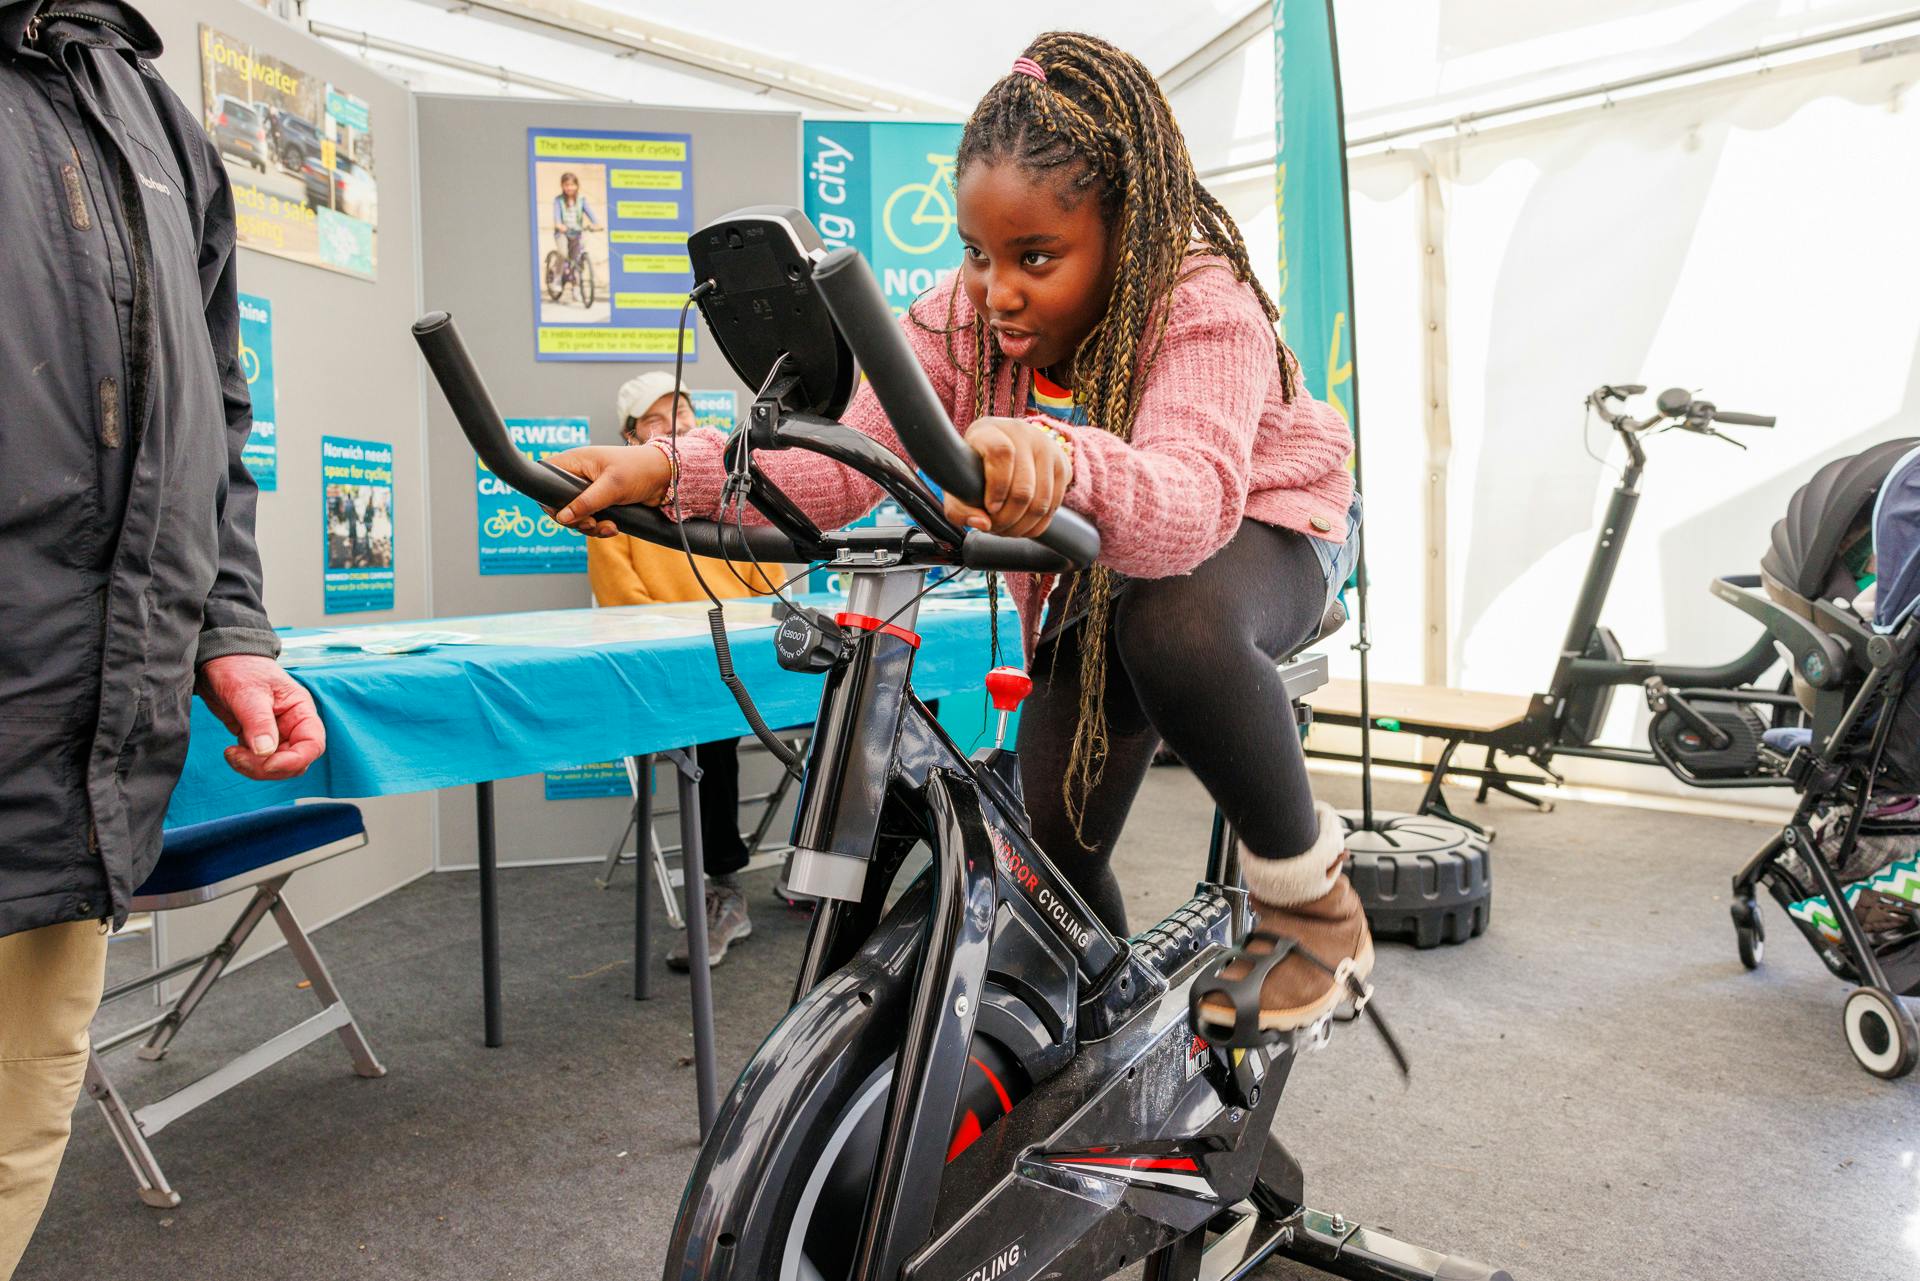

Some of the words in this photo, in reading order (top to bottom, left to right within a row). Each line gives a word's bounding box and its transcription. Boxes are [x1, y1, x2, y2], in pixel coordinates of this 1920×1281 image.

[203, 31, 298, 96] Longwater
[540, 140, 559, 150] The
[561, 141, 592, 152] health
[594, 142, 633, 154] benefits
[636, 144, 645, 153] of
[647, 145, 680, 156] cycling
[809, 135, 854, 205] city
[270, 195, 279, 215] a
[284, 198, 316, 224] safe
[238, 301, 268, 323] hine
[509, 425, 587, 444] RWICH
[323, 441, 364, 461] Norwich
[783, 629, 805, 642] LOOSEN
[1038, 889, 1089, 948] CYCLING
